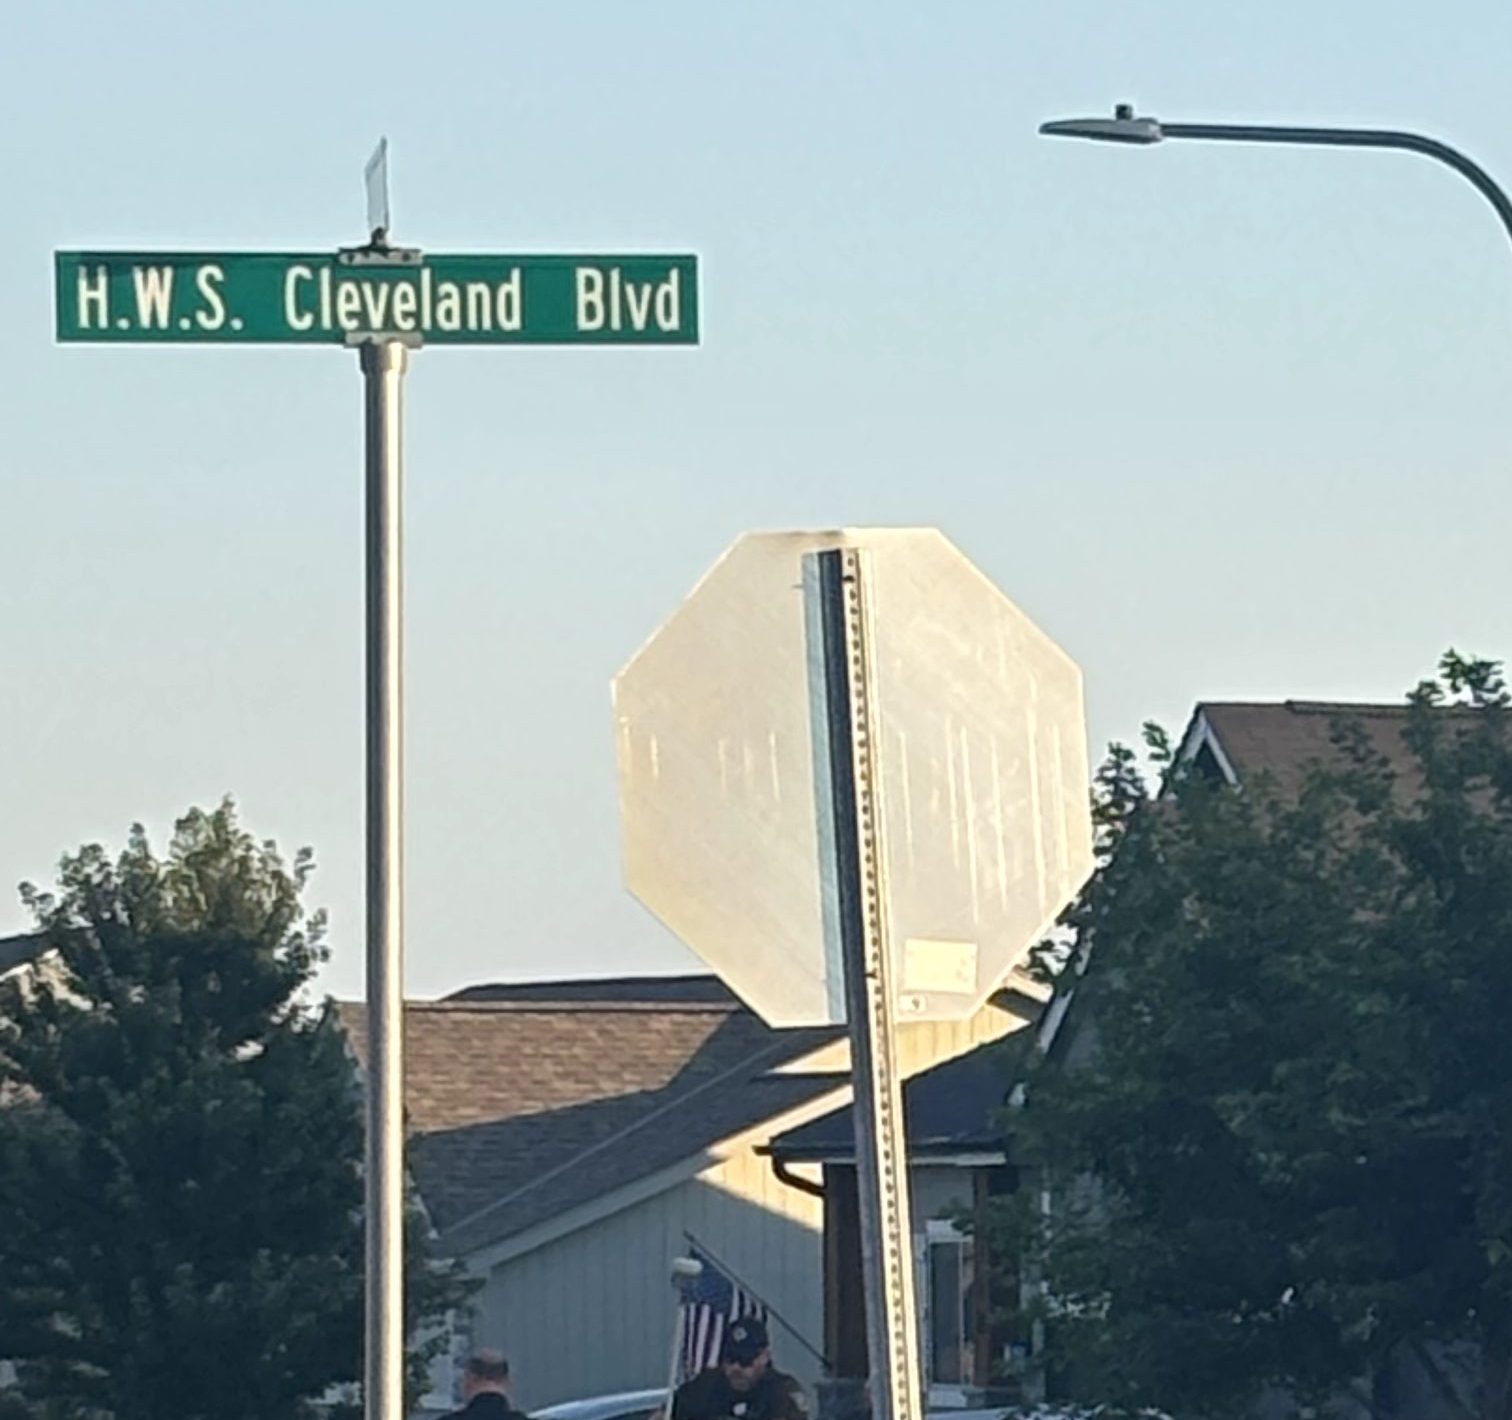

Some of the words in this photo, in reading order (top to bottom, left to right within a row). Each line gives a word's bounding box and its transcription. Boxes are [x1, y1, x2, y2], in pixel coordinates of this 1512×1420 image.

[78, 265, 243, 331] H.W.S.
[284, 266, 522, 333] Cleveland
[574, 268, 681, 332] Blvd
